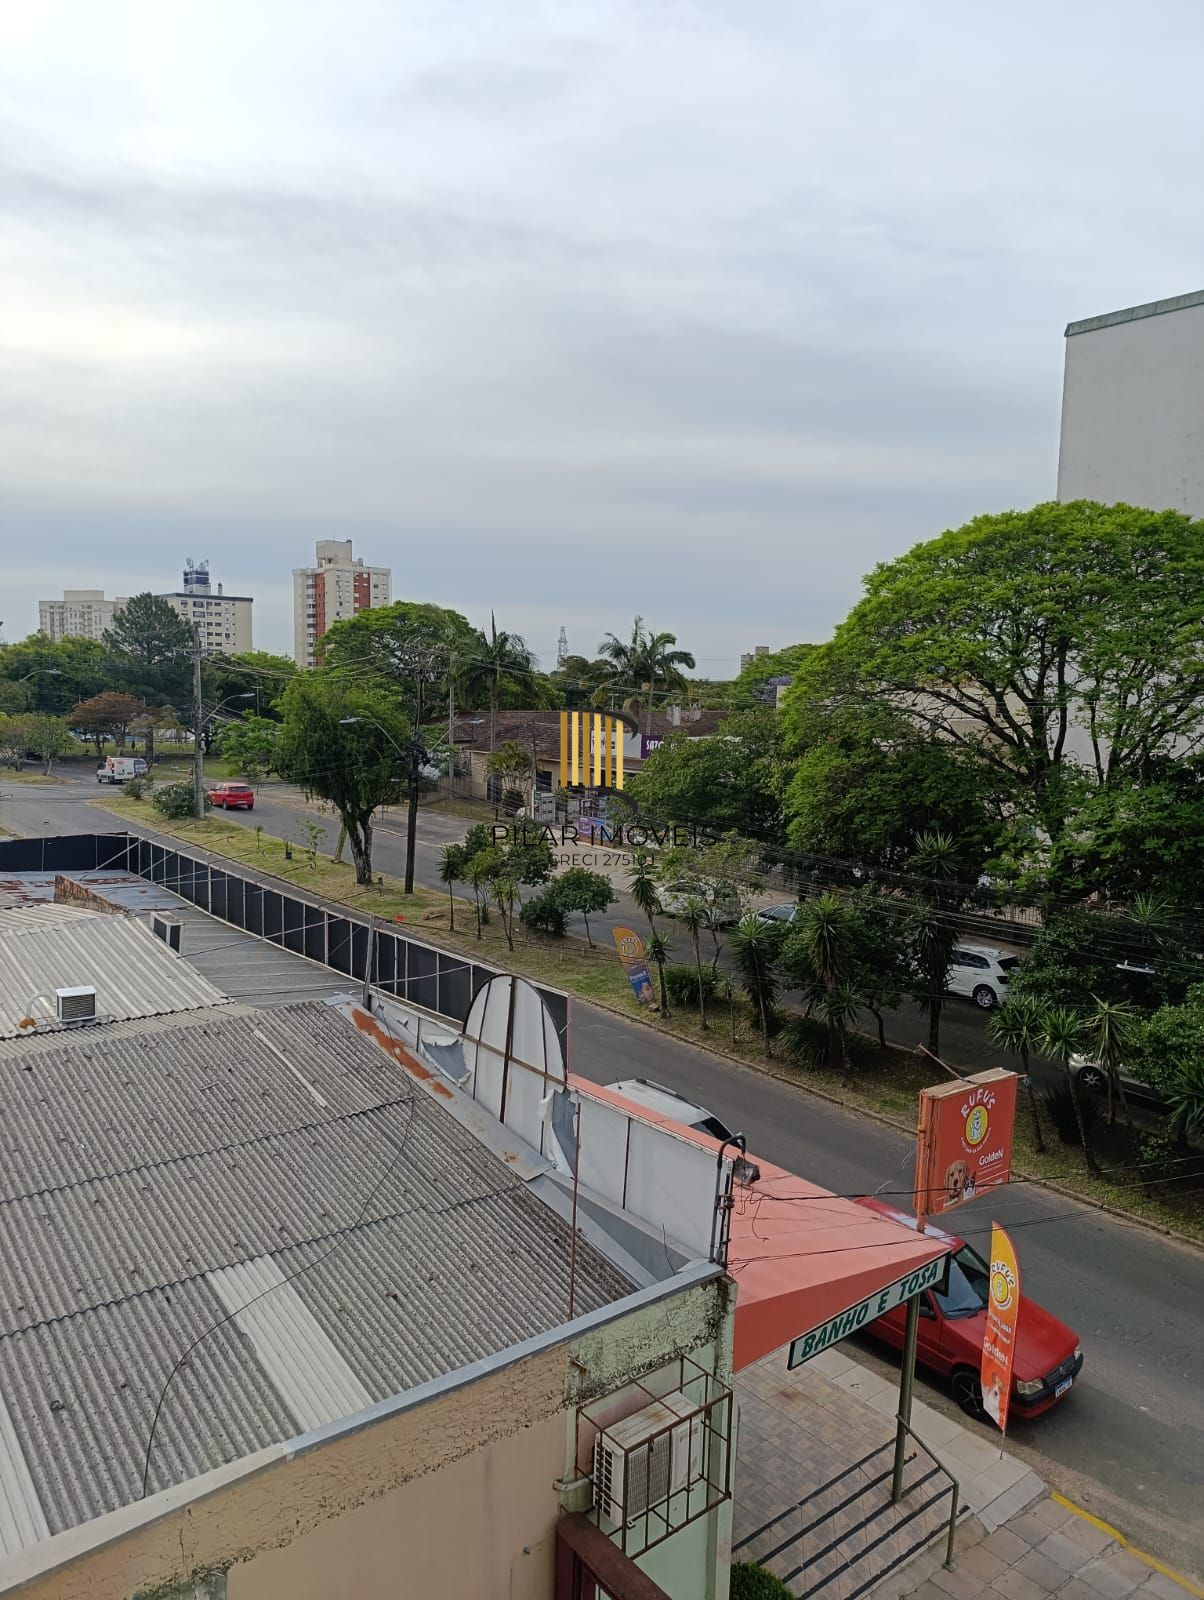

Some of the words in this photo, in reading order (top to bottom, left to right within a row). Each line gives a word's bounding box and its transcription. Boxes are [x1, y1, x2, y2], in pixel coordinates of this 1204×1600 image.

[961, 1088, 996, 1118] RUFU'S
[801, 1302, 869, 1358] BANHO
[877, 1290, 890, 1314] E
[898, 1262, 939, 1301] TOSA
